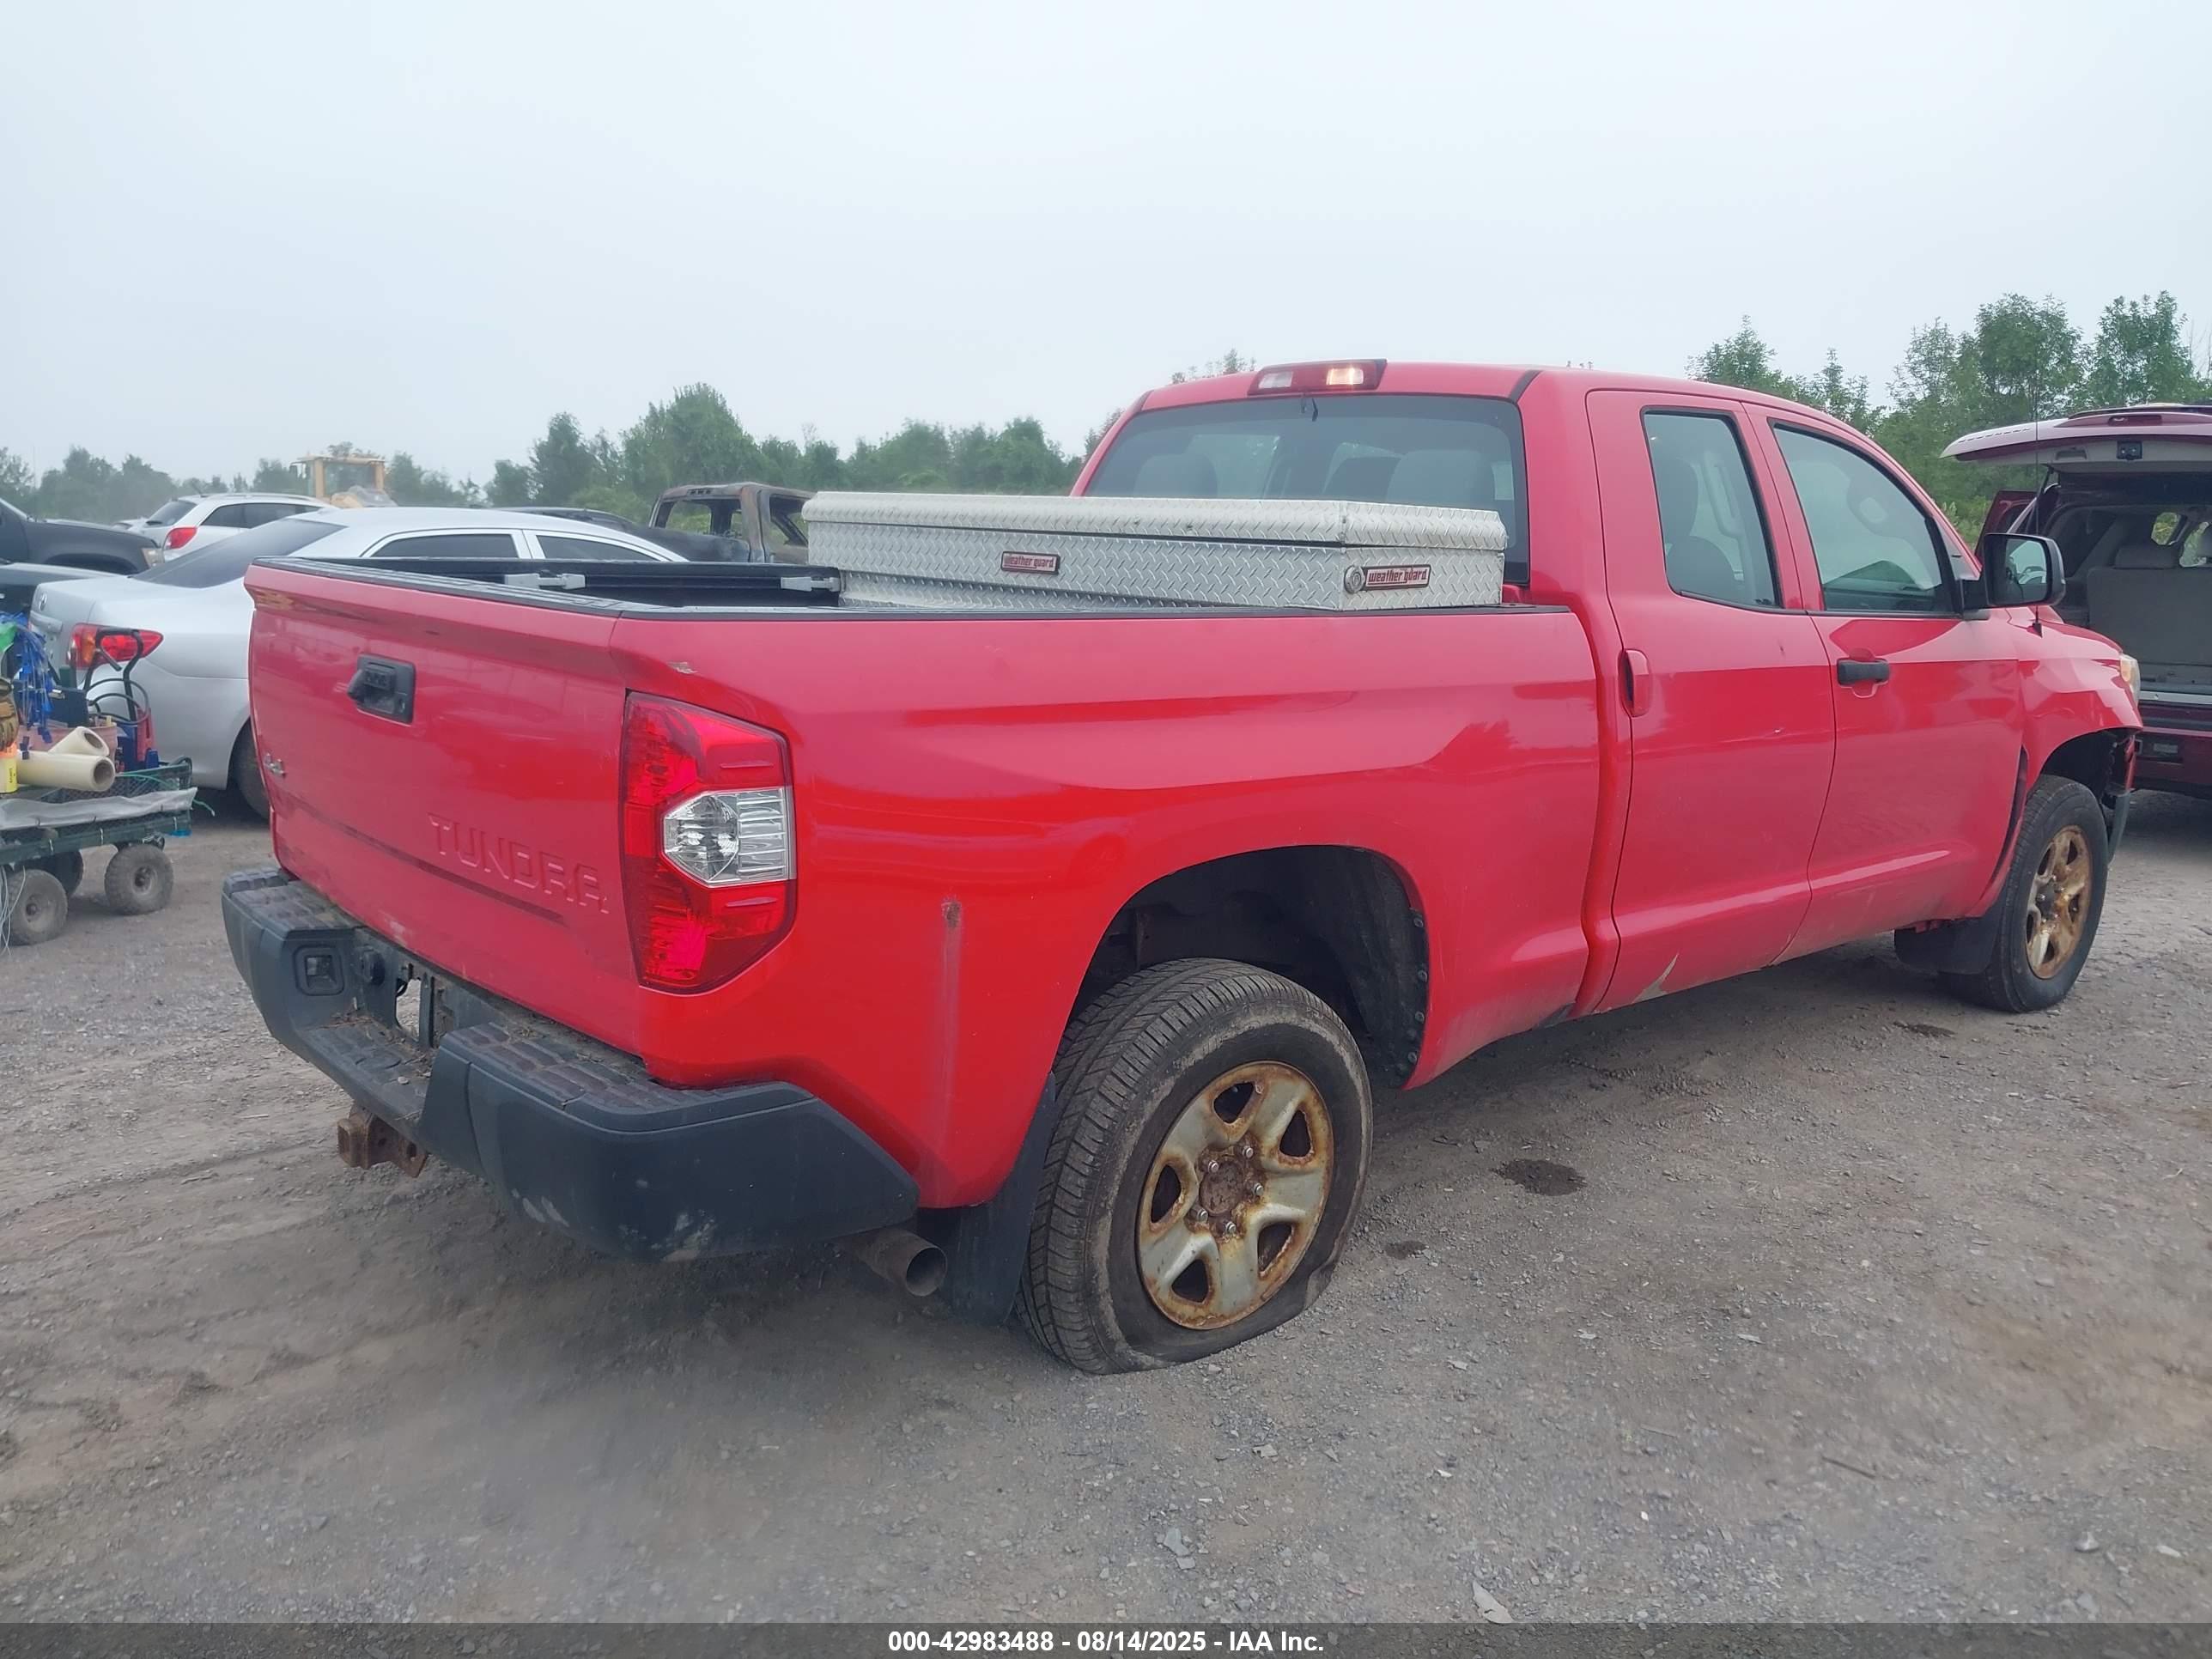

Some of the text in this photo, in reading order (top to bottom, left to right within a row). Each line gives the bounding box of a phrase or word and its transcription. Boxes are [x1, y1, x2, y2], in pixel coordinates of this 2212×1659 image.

[1368, 568, 1428, 582] weather guard
[427, 811, 611, 915] TUNDRA
